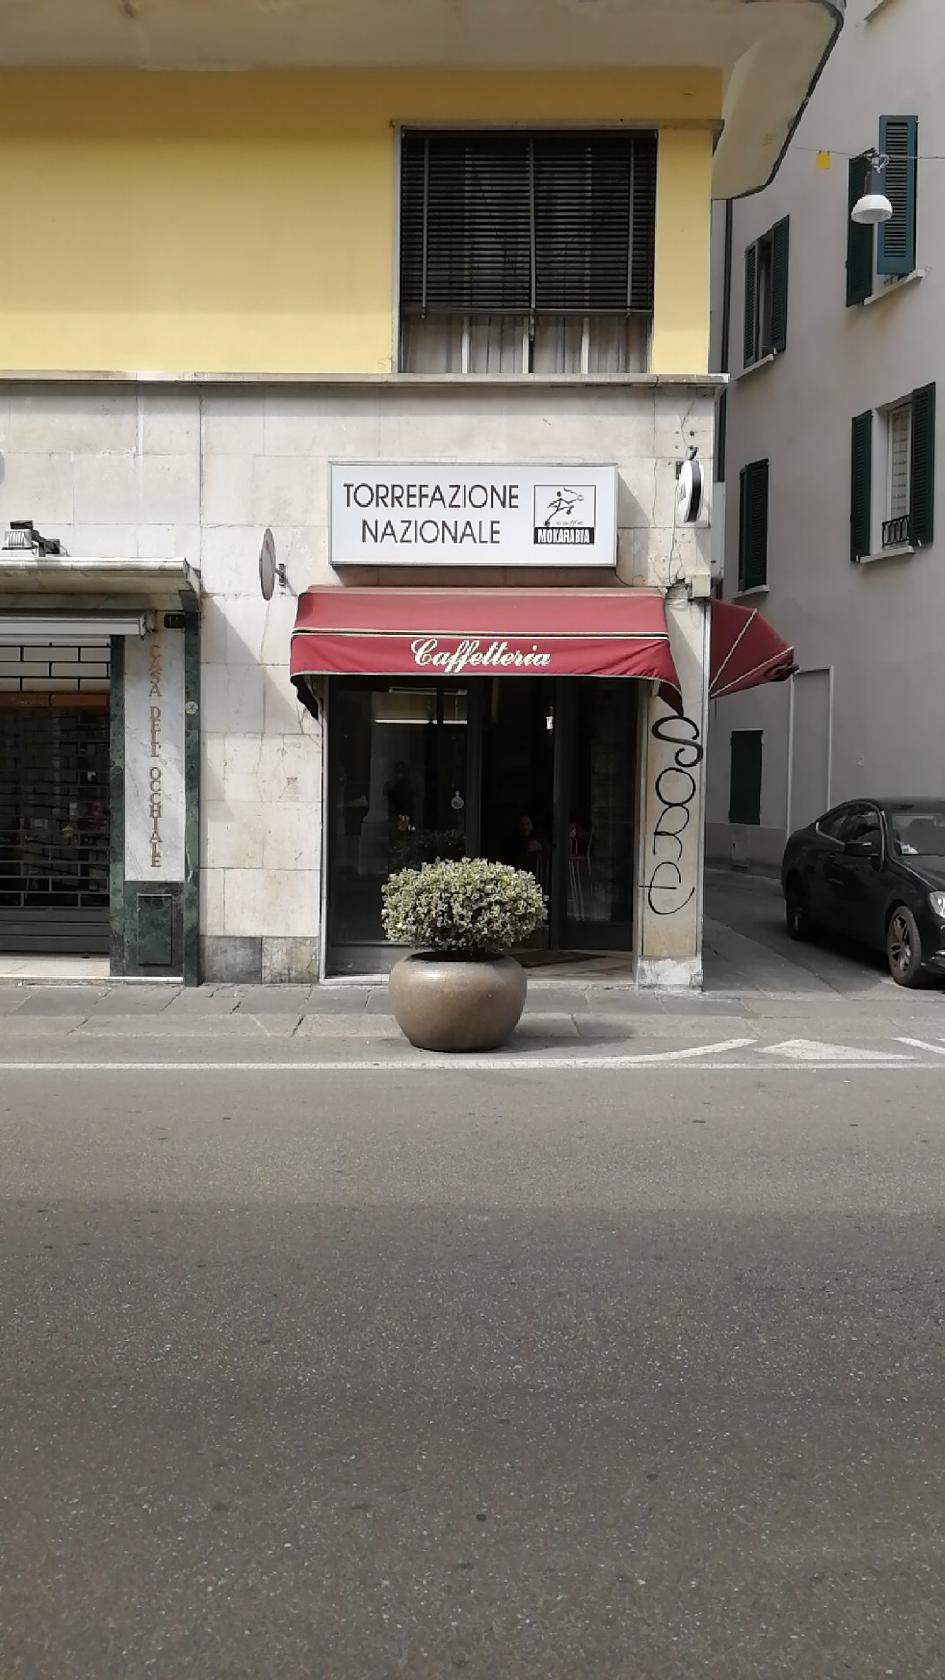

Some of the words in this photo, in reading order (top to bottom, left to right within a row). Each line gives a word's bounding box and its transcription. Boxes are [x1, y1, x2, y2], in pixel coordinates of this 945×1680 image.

[343, 483, 519, 509] TORREFAZIONE
[361, 519, 500, 544] NAZIONALE
[537, 528, 590, 543] MOKARABIA
[410, 638, 551, 673] Caffetteria
[149, 766, 162, 868] OCCHIALE
